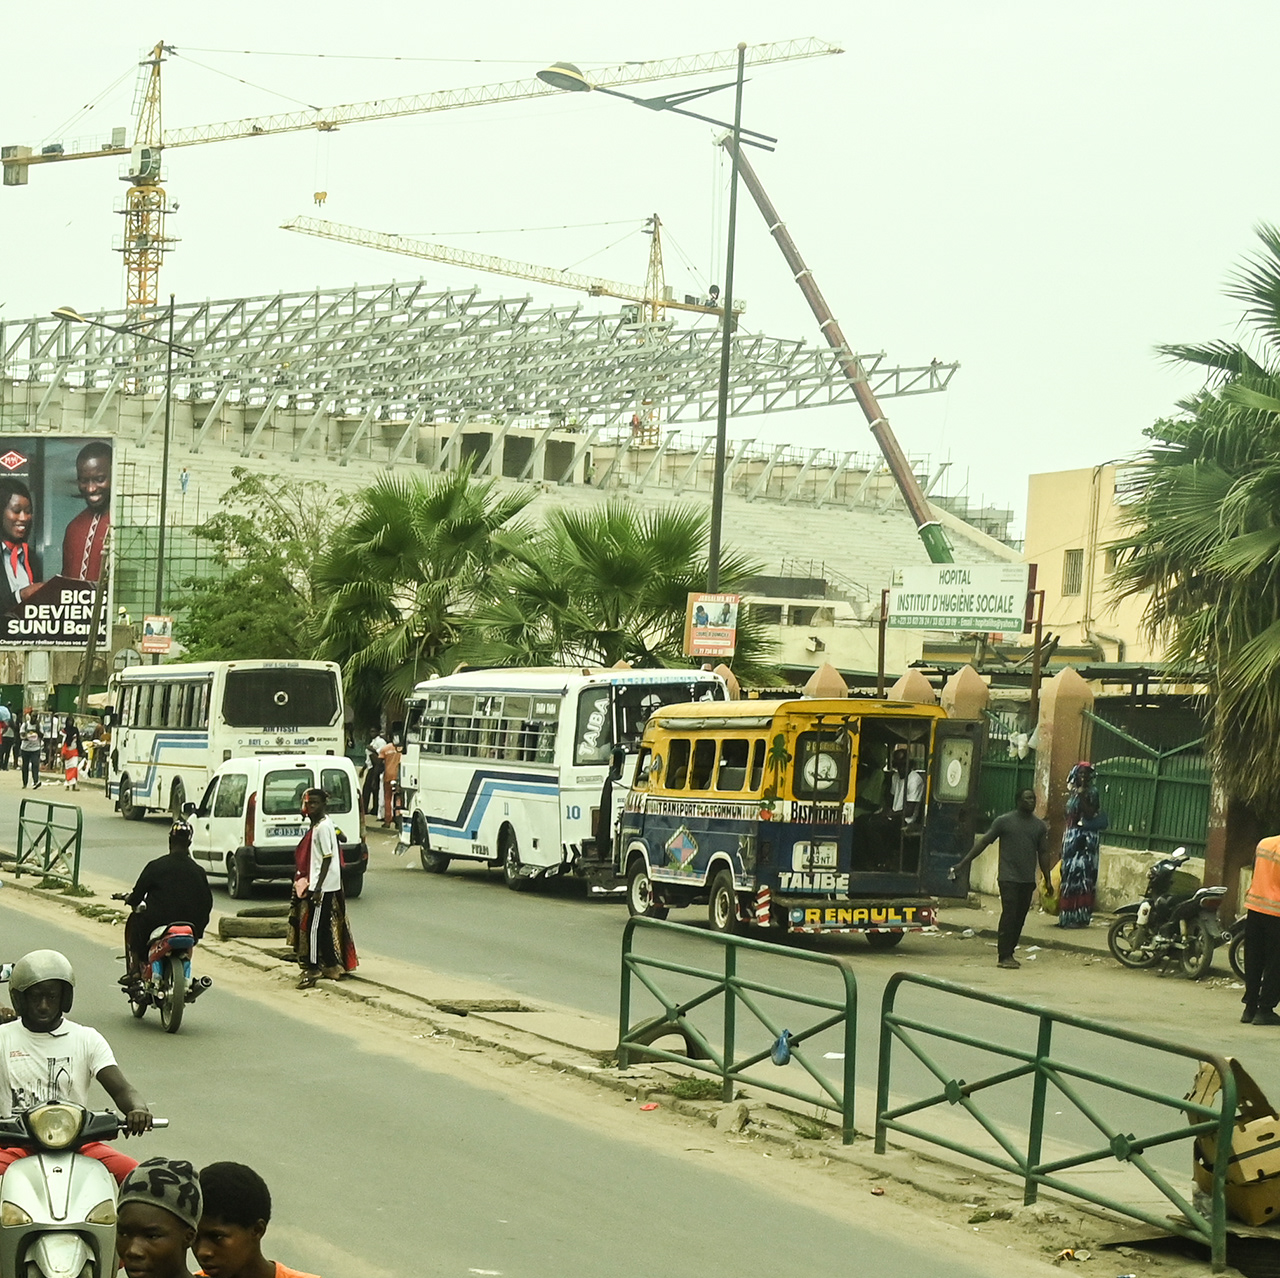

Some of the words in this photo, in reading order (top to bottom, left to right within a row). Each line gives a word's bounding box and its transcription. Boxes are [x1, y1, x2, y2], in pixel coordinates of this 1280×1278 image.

[939, 570, 971, 585] HOPITAL
[897, 594, 931, 612] INSTITUT
[975, 594, 1014, 613] SOCIALE
[7, 620, 60, 635] SUNU
[566, 805, 581, 820] 10
[658, 802, 696, 817] TRANSPORT
[714, 805, 742, 819] COMMUN
[806, 856, 819, 865] 43
[778, 872, 850, 893] TALIBE
[804, 907, 917, 924] RENAULT
